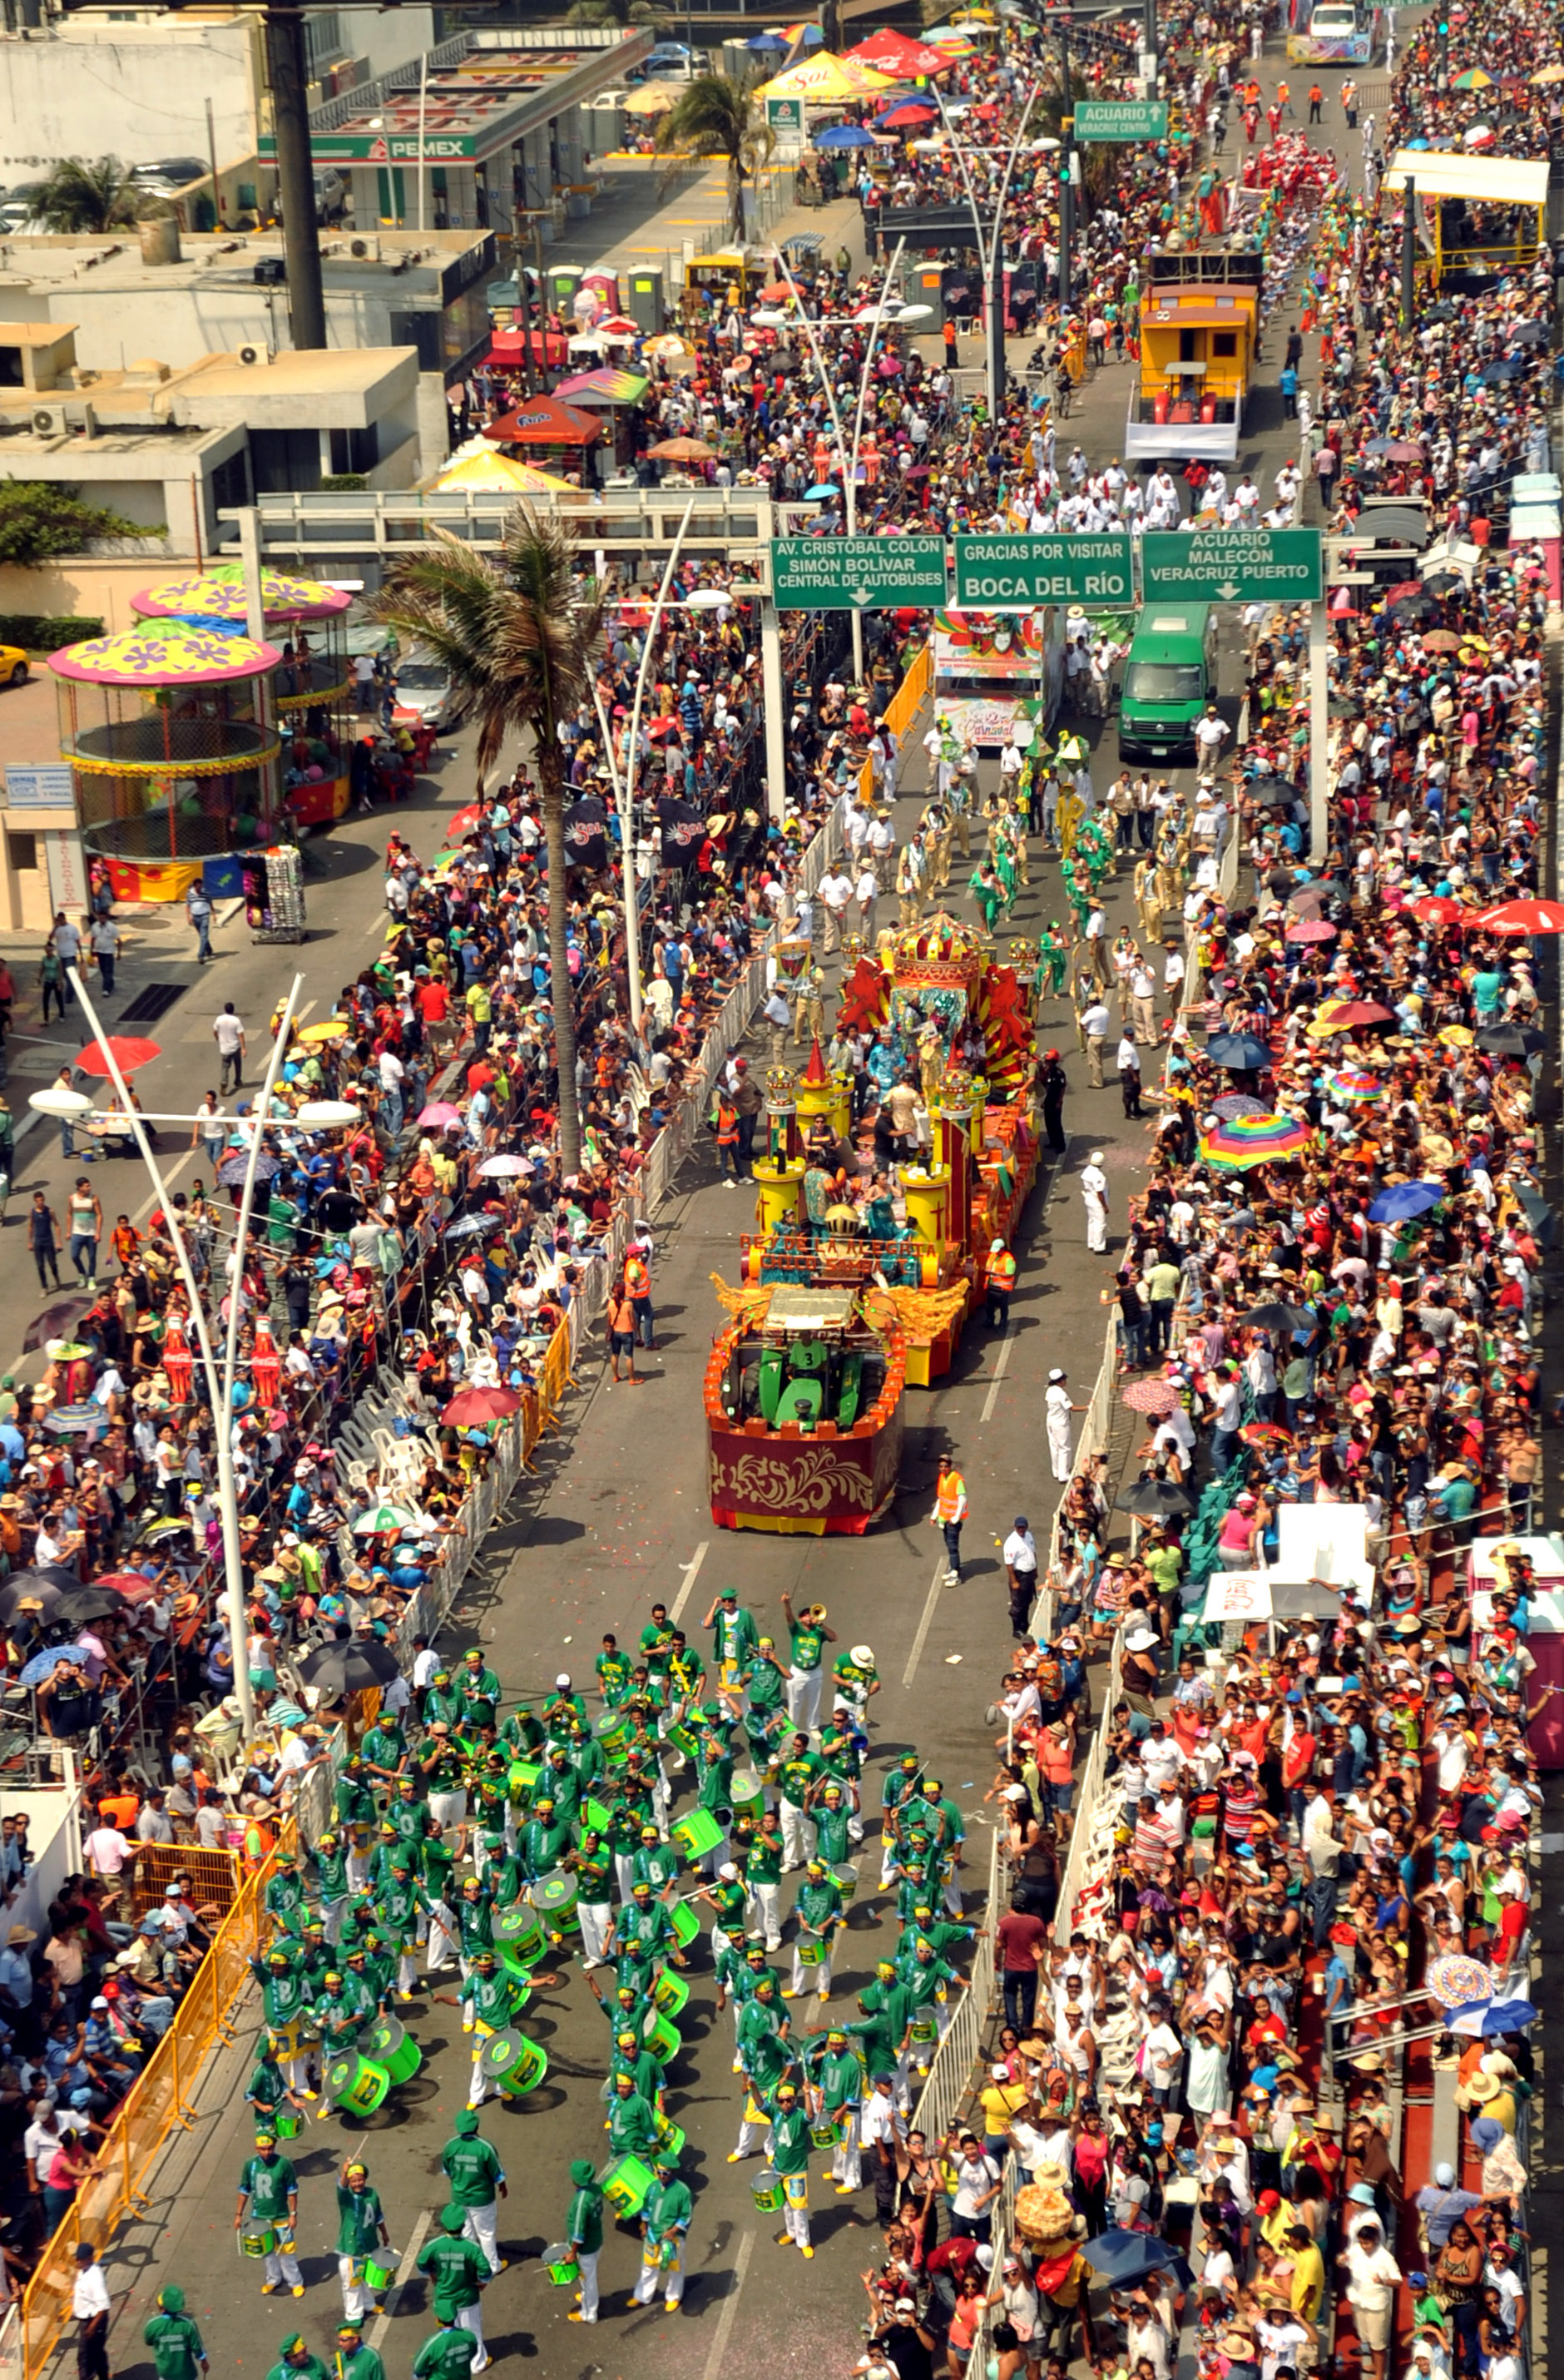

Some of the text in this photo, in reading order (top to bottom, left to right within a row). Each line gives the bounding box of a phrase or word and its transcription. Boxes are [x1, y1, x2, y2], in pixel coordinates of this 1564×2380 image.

[1085, 107, 1146, 121] ACUARIO
[1078, 123, 1151, 132] VERACRUZ CENTRO
[392, 141, 463, 156] PEMEX
[517, 414, 552, 428] Fanta
[776, 538, 939, 555] AV. CRISTÓBAL COLÓN
[1190, 533, 1270, 548] ACUARIO
[964, 543, 1123, 560] GRACIAS POR VISITAR
[1188, 548, 1273, 563] MALECÓN
[789, 556, 916, 573] SIMÓN BOLÍVAR
[1151, 565, 1309, 581] VERACRUZ PUERTO
[777, 573, 943, 588] CENTRAL DE AUTOBUSES
[965, 571, 1125, 597] BOCA DEL RÍO
[740, 1233, 938, 1257] REY DE LA ALEGRIA
[804, 1352, 814, 1366] 3
[554, 1783, 566, 1804] S
[399, 1814, 415, 1835] O
[649, 1861, 664, 1884] B
[392, 1897, 407, 1916] R
[638, 1916, 653, 1940] R
[300, 1979, 314, 2001] A
[359, 1985, 375, 2009] A
[481, 1984, 497, 2007] D
[827, 2067, 841, 2093] U
[614, 2110, 626, 2135] L
[777, 2122, 792, 2147] A
[255, 2173, 275, 2199] R
[363, 2203, 375, 2229] A
